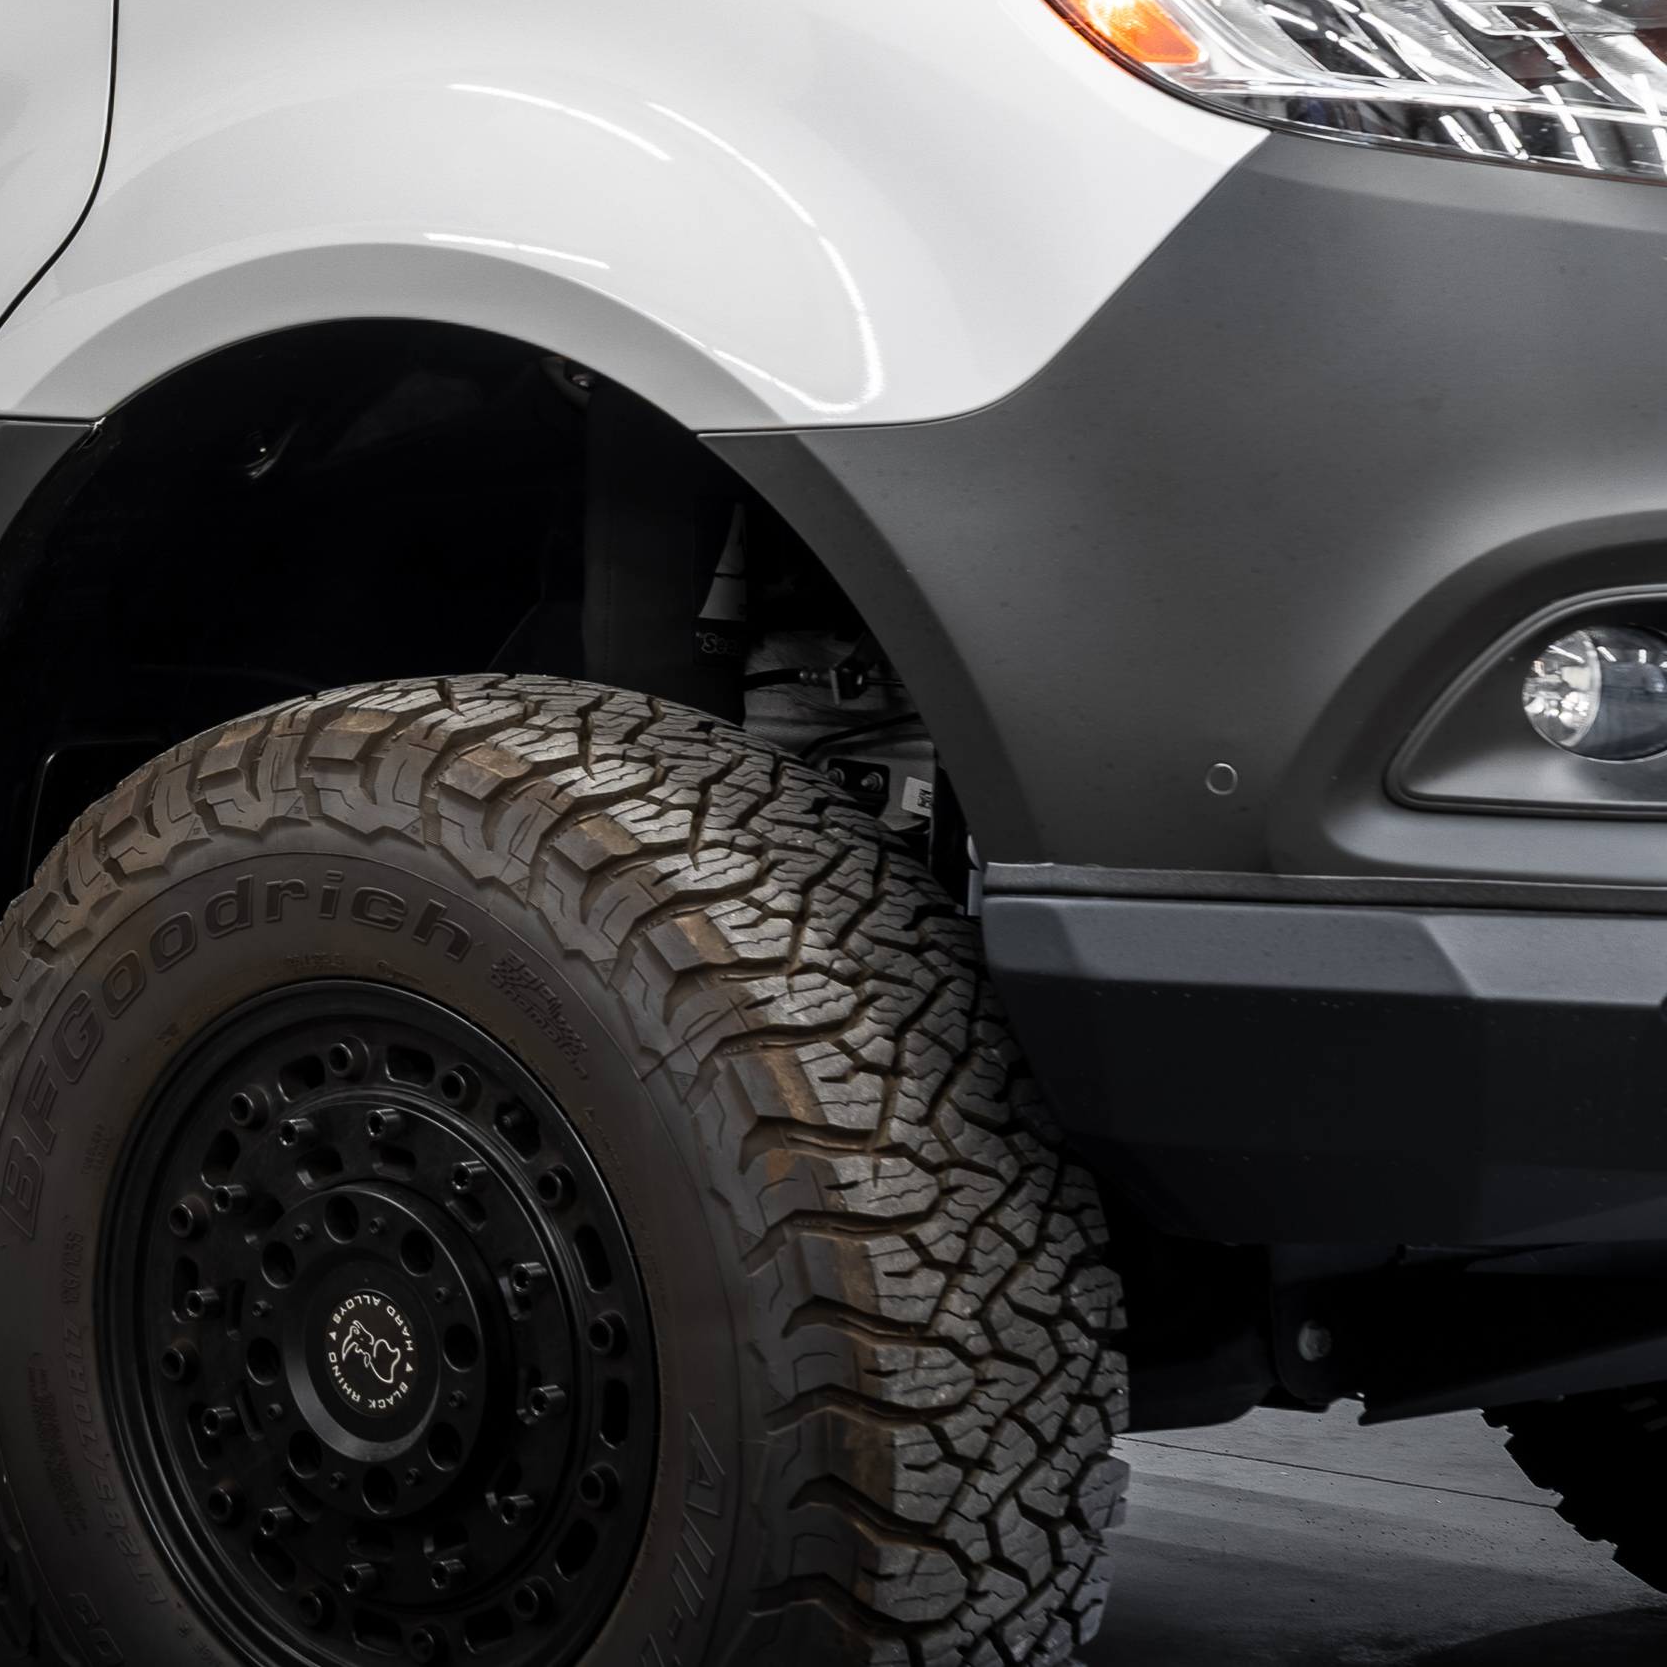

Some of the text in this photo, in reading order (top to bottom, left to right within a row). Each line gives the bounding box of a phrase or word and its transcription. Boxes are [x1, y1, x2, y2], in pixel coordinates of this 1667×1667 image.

[332, 1294, 414, 1351] HARD ALLOYS
[328, 1352, 409, 1409] BLACK RHINO
[62, 1316, 169, 1605] LT285/70R17
